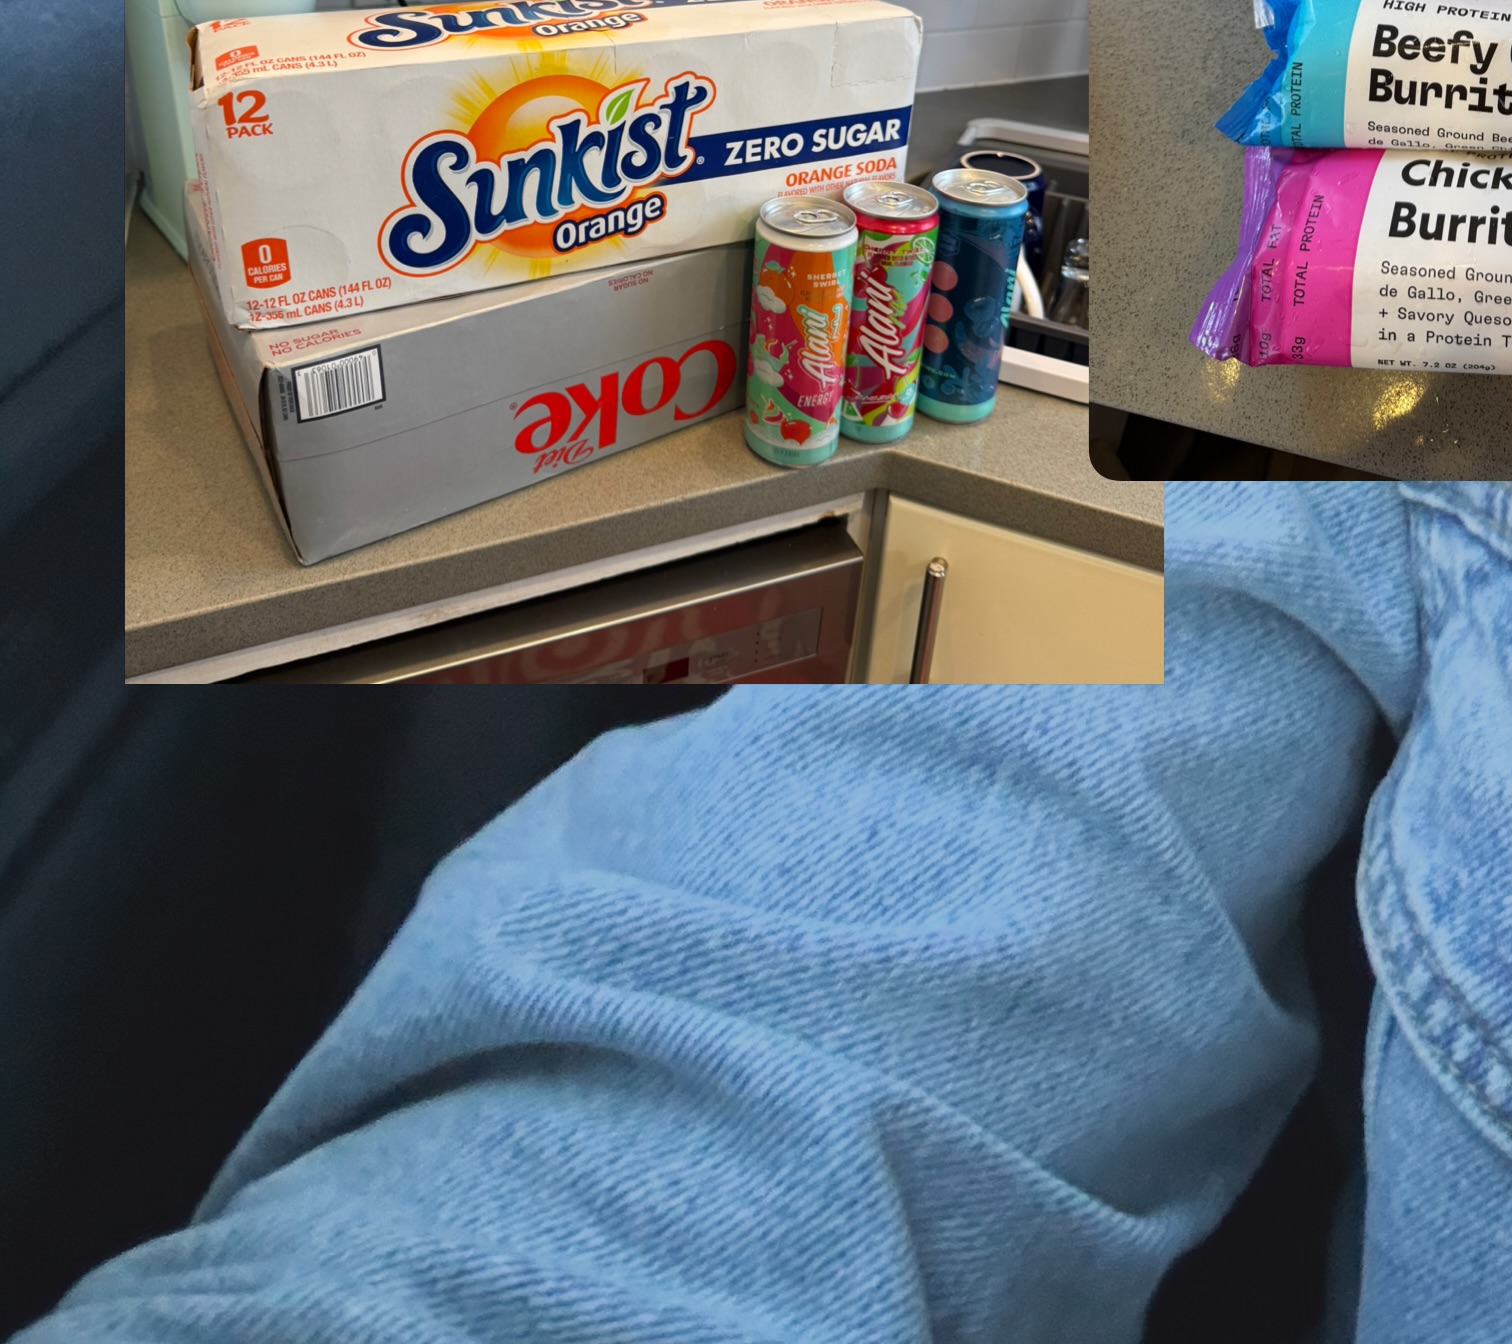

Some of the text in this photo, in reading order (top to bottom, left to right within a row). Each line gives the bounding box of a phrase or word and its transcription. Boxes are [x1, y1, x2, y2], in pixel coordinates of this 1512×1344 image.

[535, 11, 642, 37] Orange
[1382, 0, 1512, 23] HIGH PROTEIN
[1372, 23, 1499, 76] Beefy
[1291, 62, 1304, 116] PROTEIN
[217, 90, 270, 126] 12
[226, 123, 274, 139] PACK
[724, 118, 901, 166] ZERO SUGAR
[1367, 121, 1430, 137] Seasoned
[1436, 127, 1485, 142] Ground
[1368, 137, 1384, 147] de
[388, 80, 708, 269] Sunkist
[785, 157, 898, 188] ORANGE SODA
[556, 196, 663, 250] Orange
[258, 243, 272, 265] 0
[1261, 224, 1282, 302] TOTAL FAT
[247, 262, 287, 277] CALORIES
[253, 273, 284, 284] PER CAN
[806, 269, 847, 281] SHERBET
[1291, 195, 1325, 360] 33g TOTAL PROTEIN
[1380, 261, 1456, 280] Seasoned
[246, 276, 392, 311] 12-12 FL OZ CANS (144 FL OZ)
[1000, 268, 1017, 329] Alani
[1379, 284, 1398, 297] de
[1407, 286, 1463, 304] Gallo,
[286, 298, 353, 319] mL CANS (4.3
[1397, 307, 1455, 326] Savory
[1464, 311, 1512, 327] Queso
[859, 270, 906, 380] Alani
[1378, 328, 1397, 342] in
[1407, 331, 1415, 343] a
[1426, 330, 1492, 347] Protein
[268, 329, 338, 350] NO SUGAR
[271, 328, 362, 356] NO CALORIES
[801, 307, 838, 388] Alani
[513, 339, 737, 454] Coke
[797, 390, 834, 408] ENERGY
[533, 438, 594, 474] Diet
